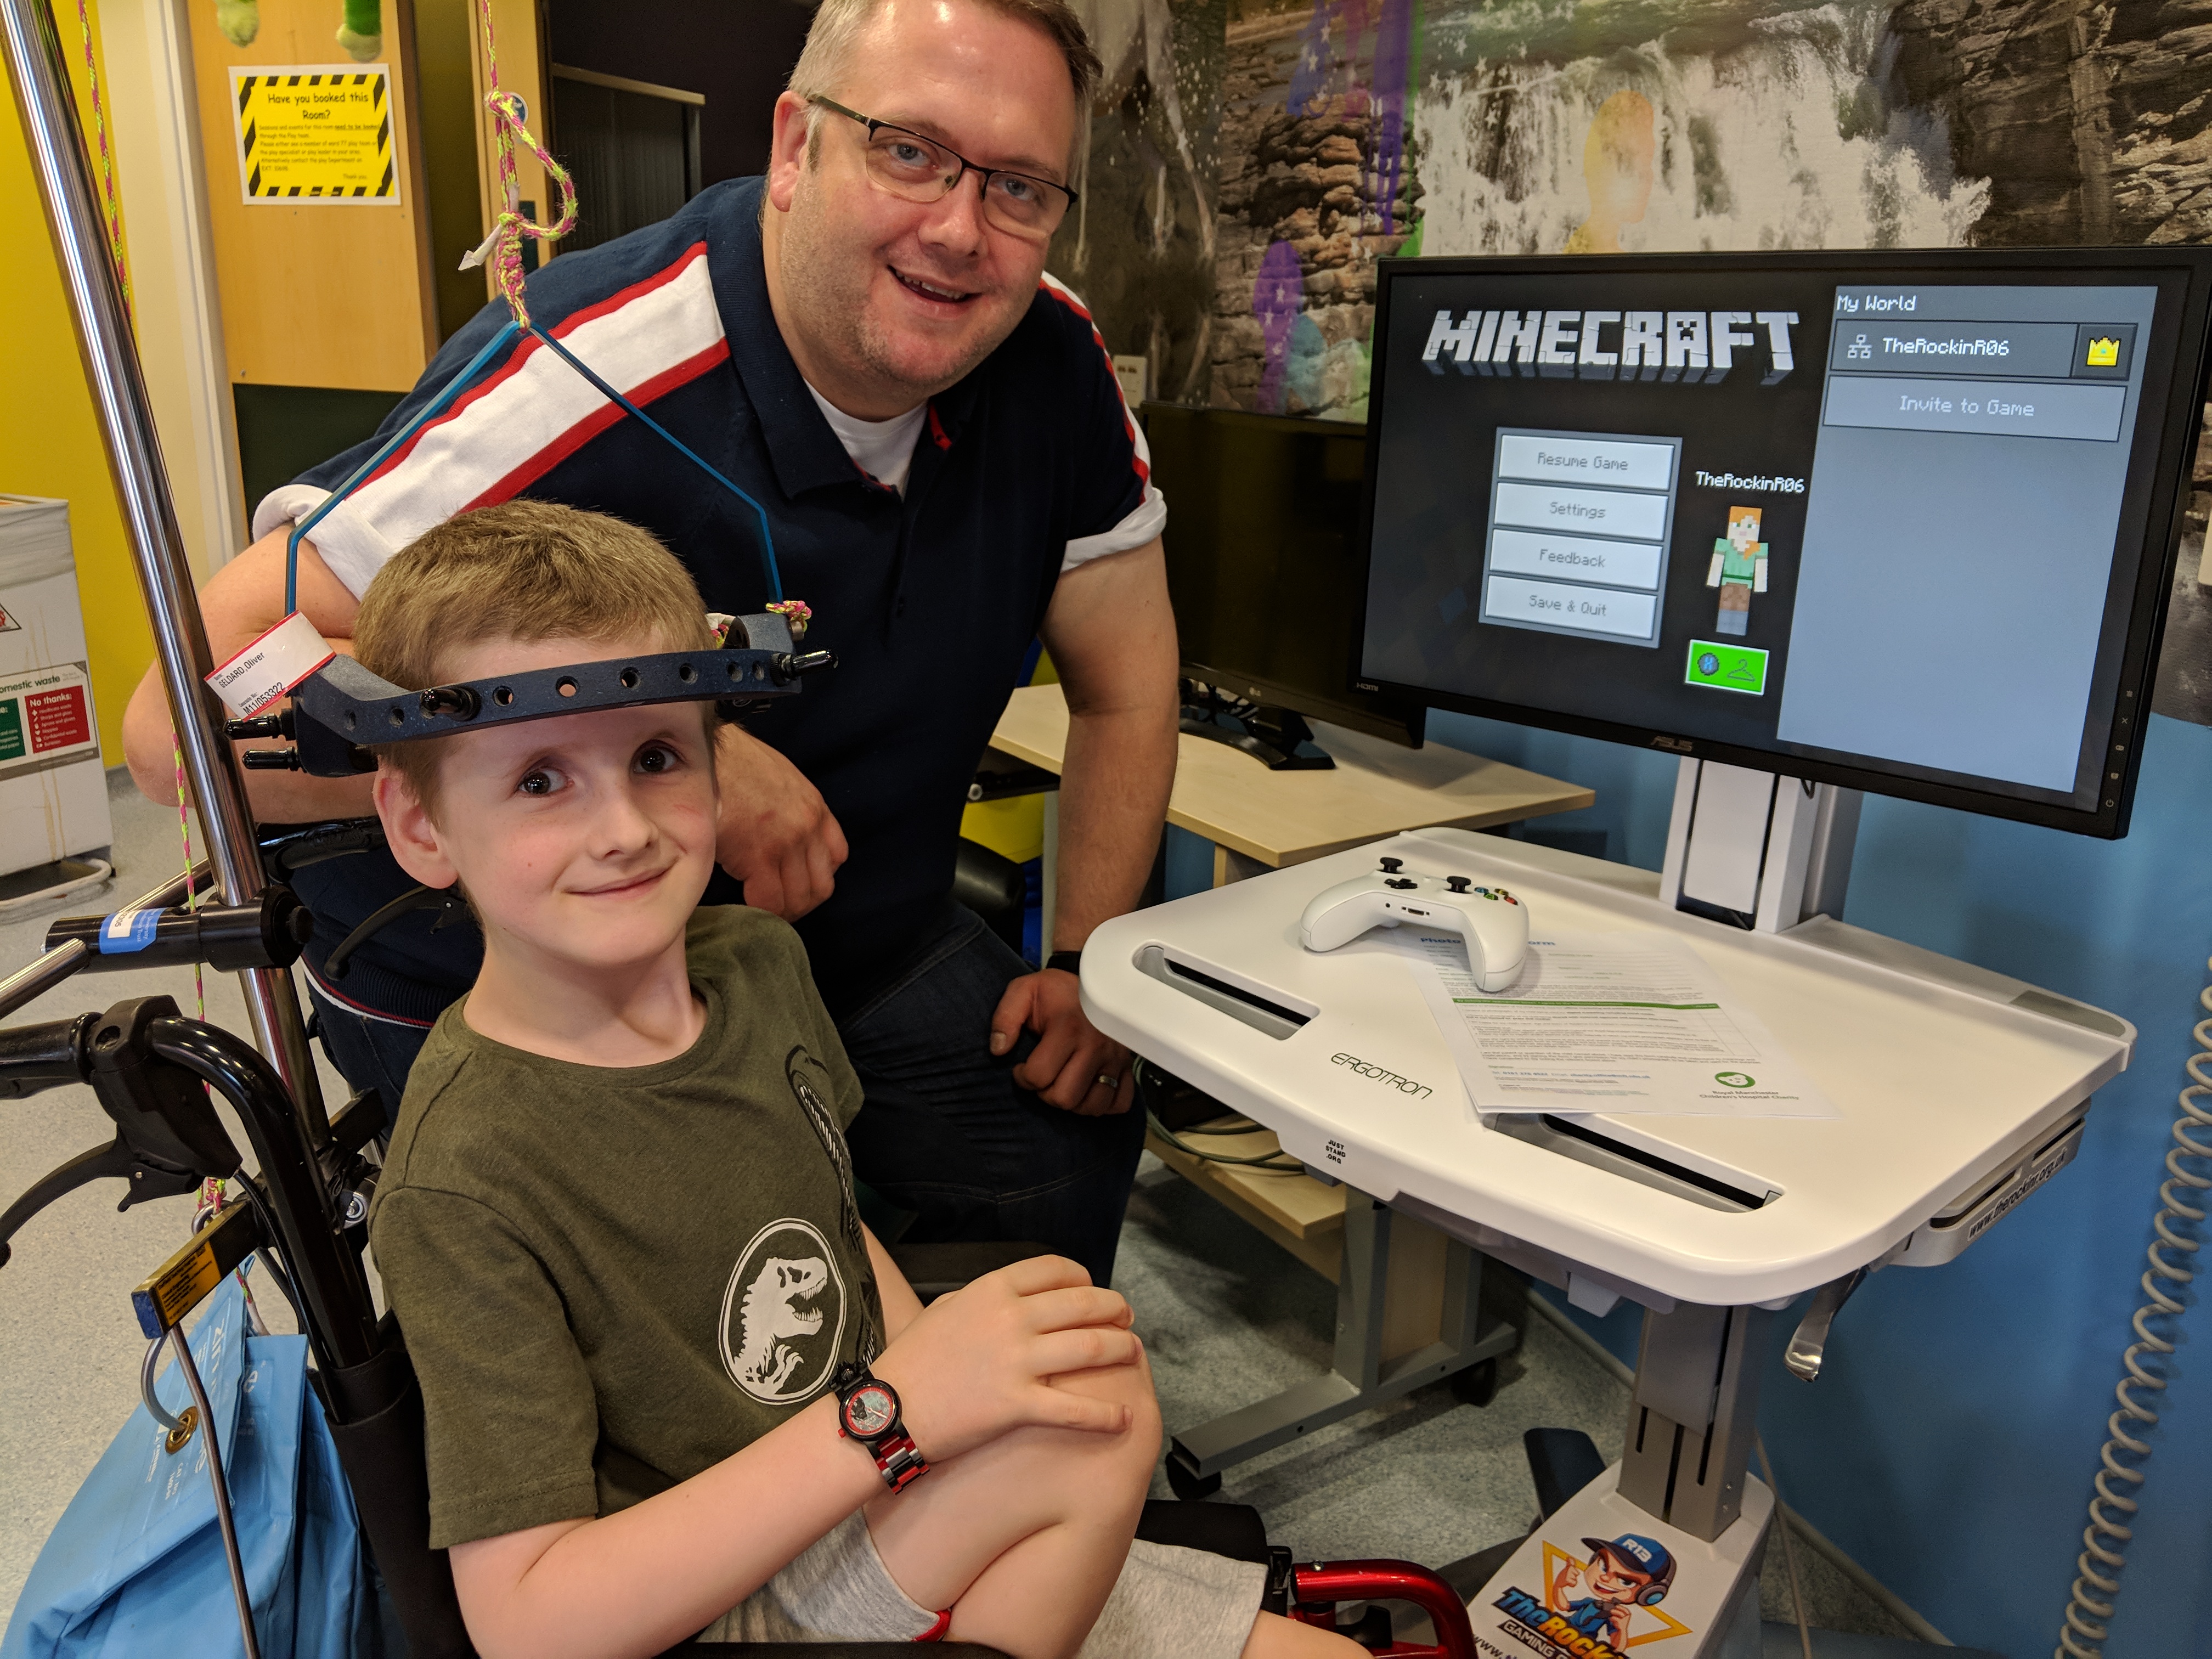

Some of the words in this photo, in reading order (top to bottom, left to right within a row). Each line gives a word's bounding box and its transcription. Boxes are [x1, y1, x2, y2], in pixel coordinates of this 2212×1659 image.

[268, 94, 290, 103] Have
[295, 95, 310, 106] you
[314, 92, 346, 103] booked
[350, 92, 369, 102] this
[303, 110, 331, 119] Room?
[1836, 295, 1859, 313] My
[1865, 295, 1916, 312] World
[1422, 310, 1799, 384] MINECRAFT
[1899, 395, 1952, 413] Invite
[1961, 398, 1979, 414] to
[1987, 399, 2035, 417] Game
[1537, 453, 1588, 469] Resume
[1593, 456, 1628, 471] Game
[1549, 502, 1606, 519] Settings
[1539, 549, 1605, 568] Feedback
[1529, 595, 1561, 611] Save
[1568, 600, 1576, 612] &
[1581, 602, 1607, 617] Quit
[0, 681, 32, 693] omestic
[34, 675, 60, 687] waste
[1356, 682, 1379, 692] HDMI
[30, 698, 42, 708] No
[43, 693, 72, 704] thanks:
[1650, 736, 1693, 752] ASUS
[1330, 1052, 1433, 1100] ERGOTRON
[1325, 1145, 1346, 1158] STAND
[1328, 1139, 1345, 1150] JUST
[1326, 1154, 1342, 1165] .ORG
[1503, 1621, 1555, 1658] GAMING
